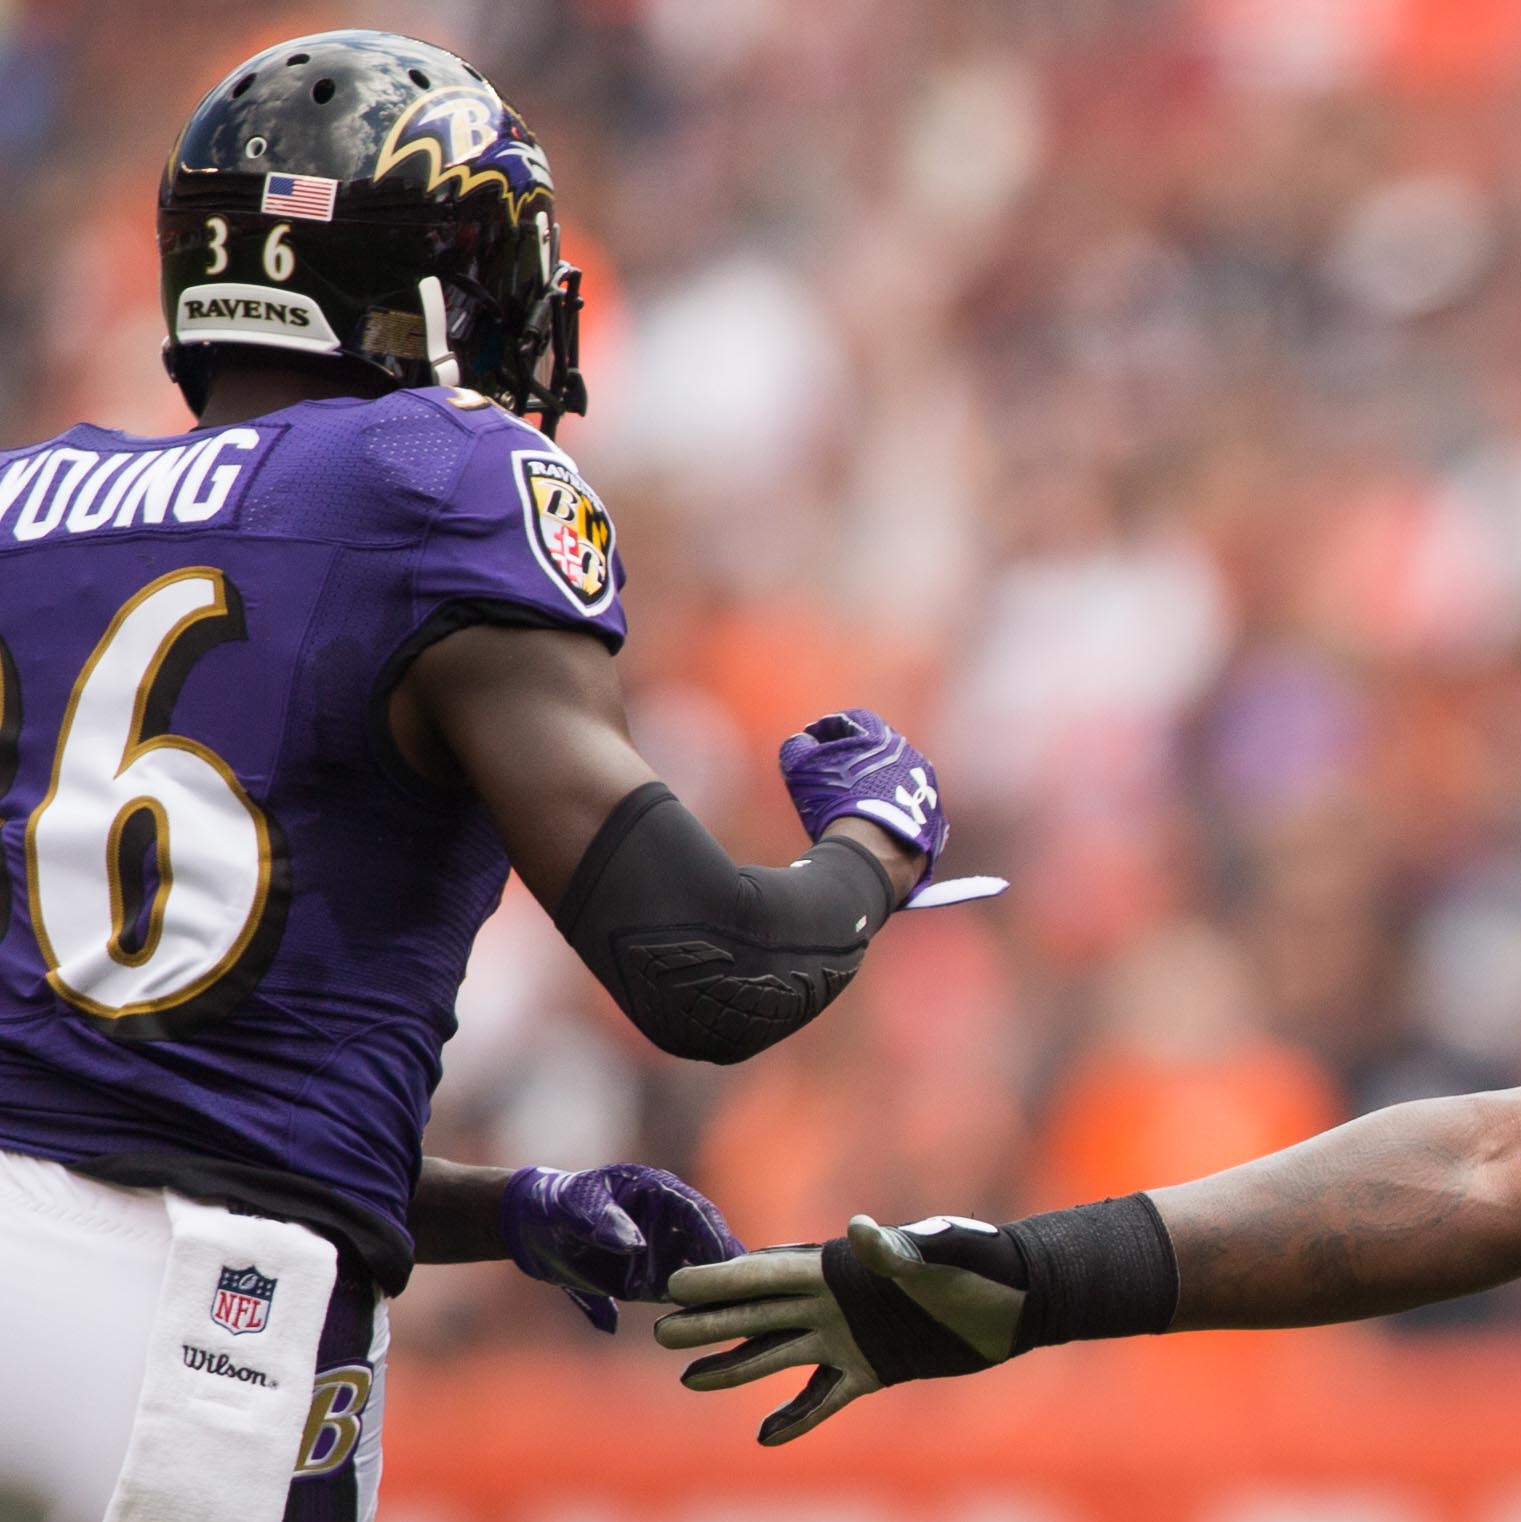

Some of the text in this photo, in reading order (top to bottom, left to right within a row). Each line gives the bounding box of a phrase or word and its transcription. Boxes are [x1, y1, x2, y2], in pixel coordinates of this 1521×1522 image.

[184, 299, 310, 328] RAVENS
[0, 427, 260, 542] YOUNG
[214, 1290, 263, 1331] NFL
[182, 1343, 267, 1388] Wilson
